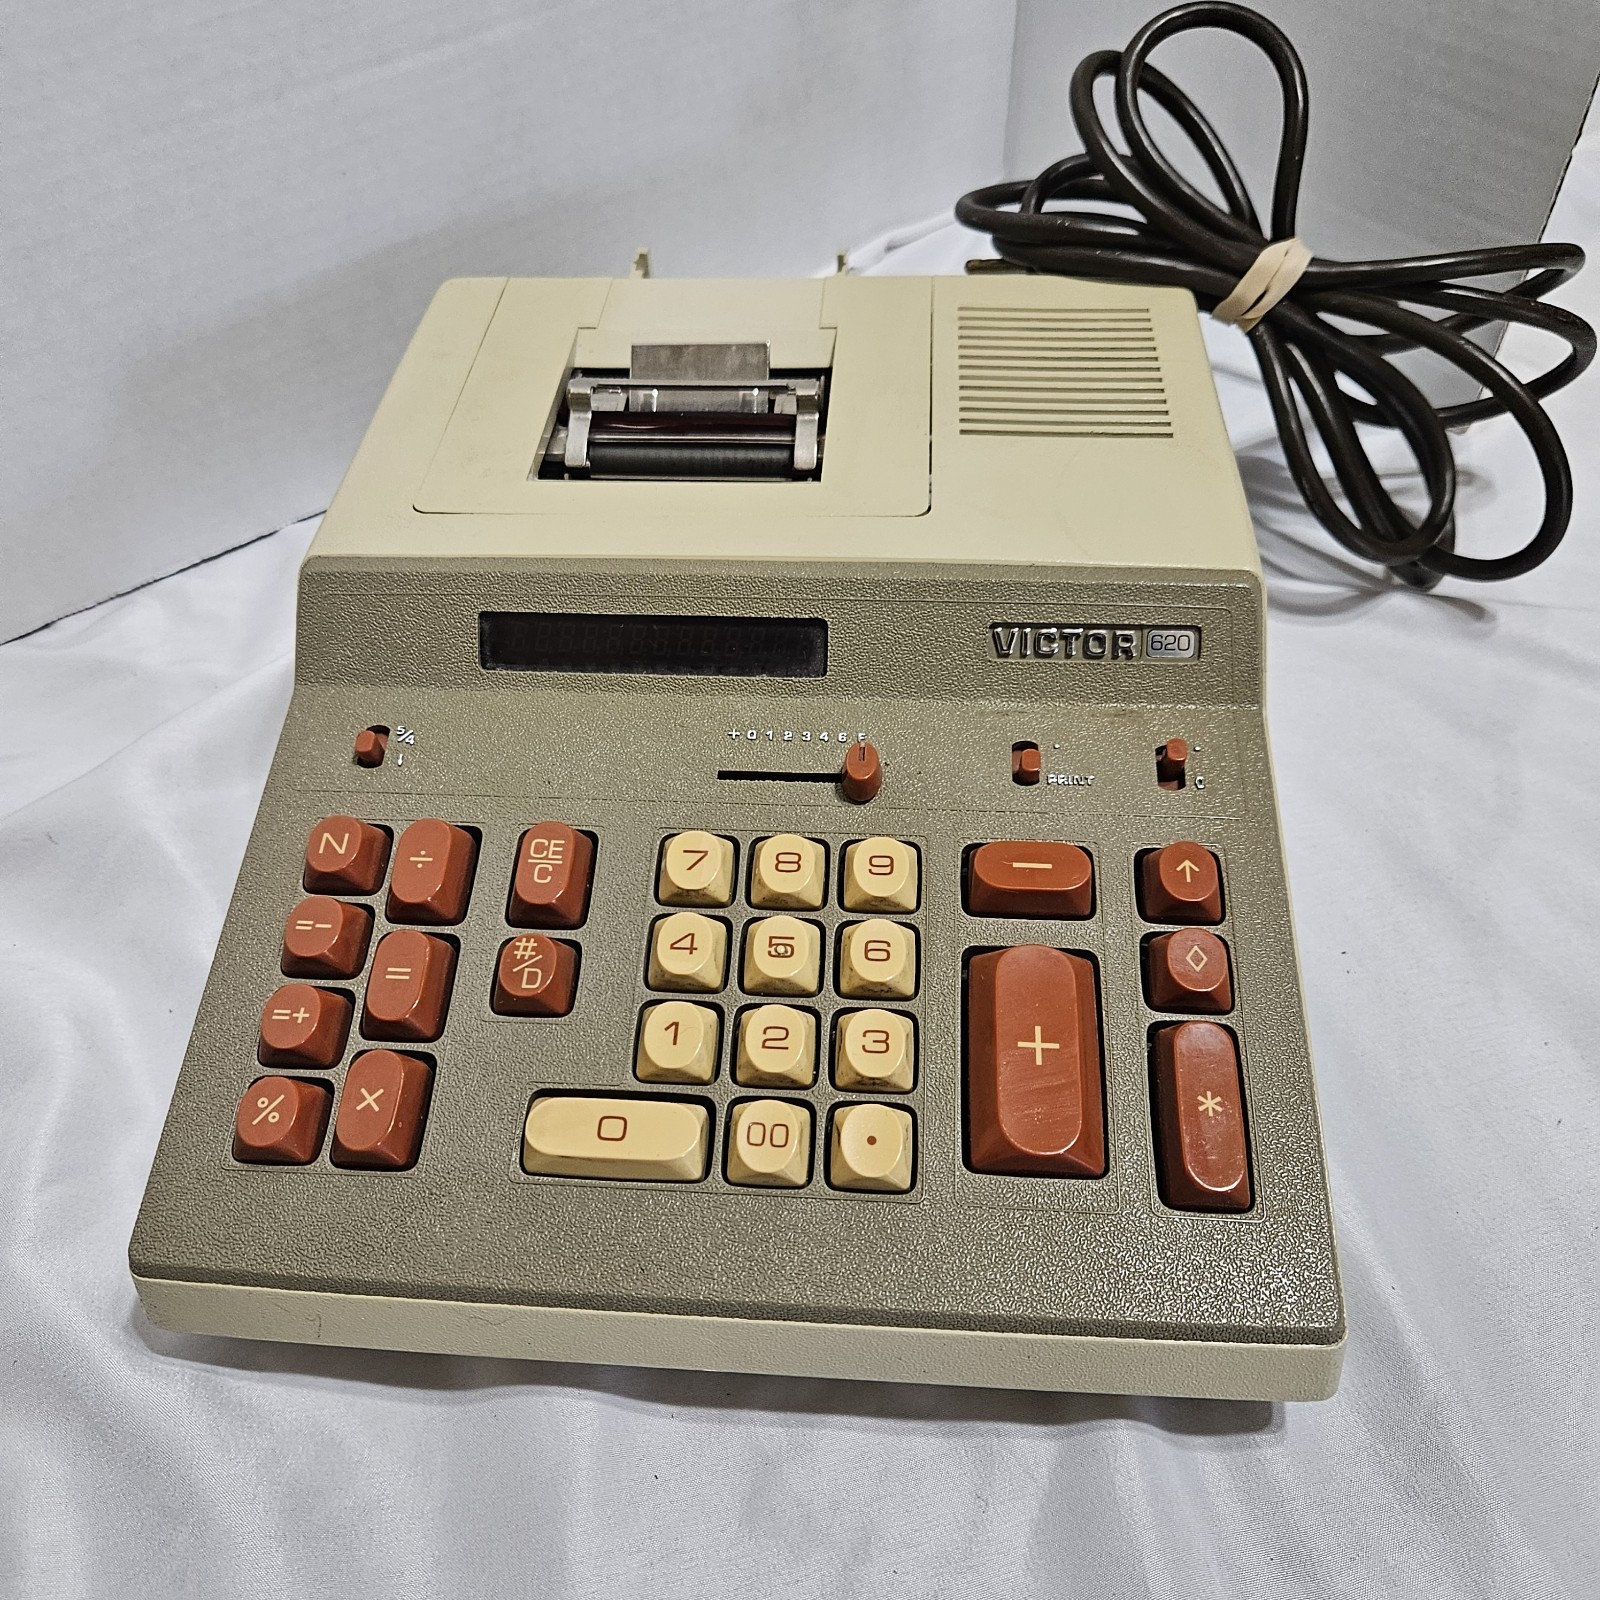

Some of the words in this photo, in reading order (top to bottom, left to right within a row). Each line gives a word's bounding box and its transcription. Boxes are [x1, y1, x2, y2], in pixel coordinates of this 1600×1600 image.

[991, 626, 1138, 660] VICTOR
[1150, 634, 1191, 652] 620
[746, 729, 758, 741] 0
[765, 730, 774, 741] 1
[783, 730, 794, 742] 2
[801, 731, 812, 742] 3
[819, 731, 830, 743] 4
[1047, 773, 1096, 786] PRINT
[1195, 775, 1206, 790] C
[318, 832, 350, 855] N
[530, 838, 566, 860] CE
[682, 849, 709, 871] 7
[774, 851, 803, 874] 8
[867, 854, 895, 877] 9
[533, 863, 554, 885] C
[669, 932, 699, 956] 4
[767, 935, 796, 959] 5
[863, 939, 892, 963] 6
[663, 1020, 681, 1047] 1
[761, 1025, 791, 1051] 2
[861, 1029, 891, 1055] 3
[251, 1093, 286, 1126] %
[596, 1115, 628, 1142] 0
[746, 1120, 790, 1149] 00
